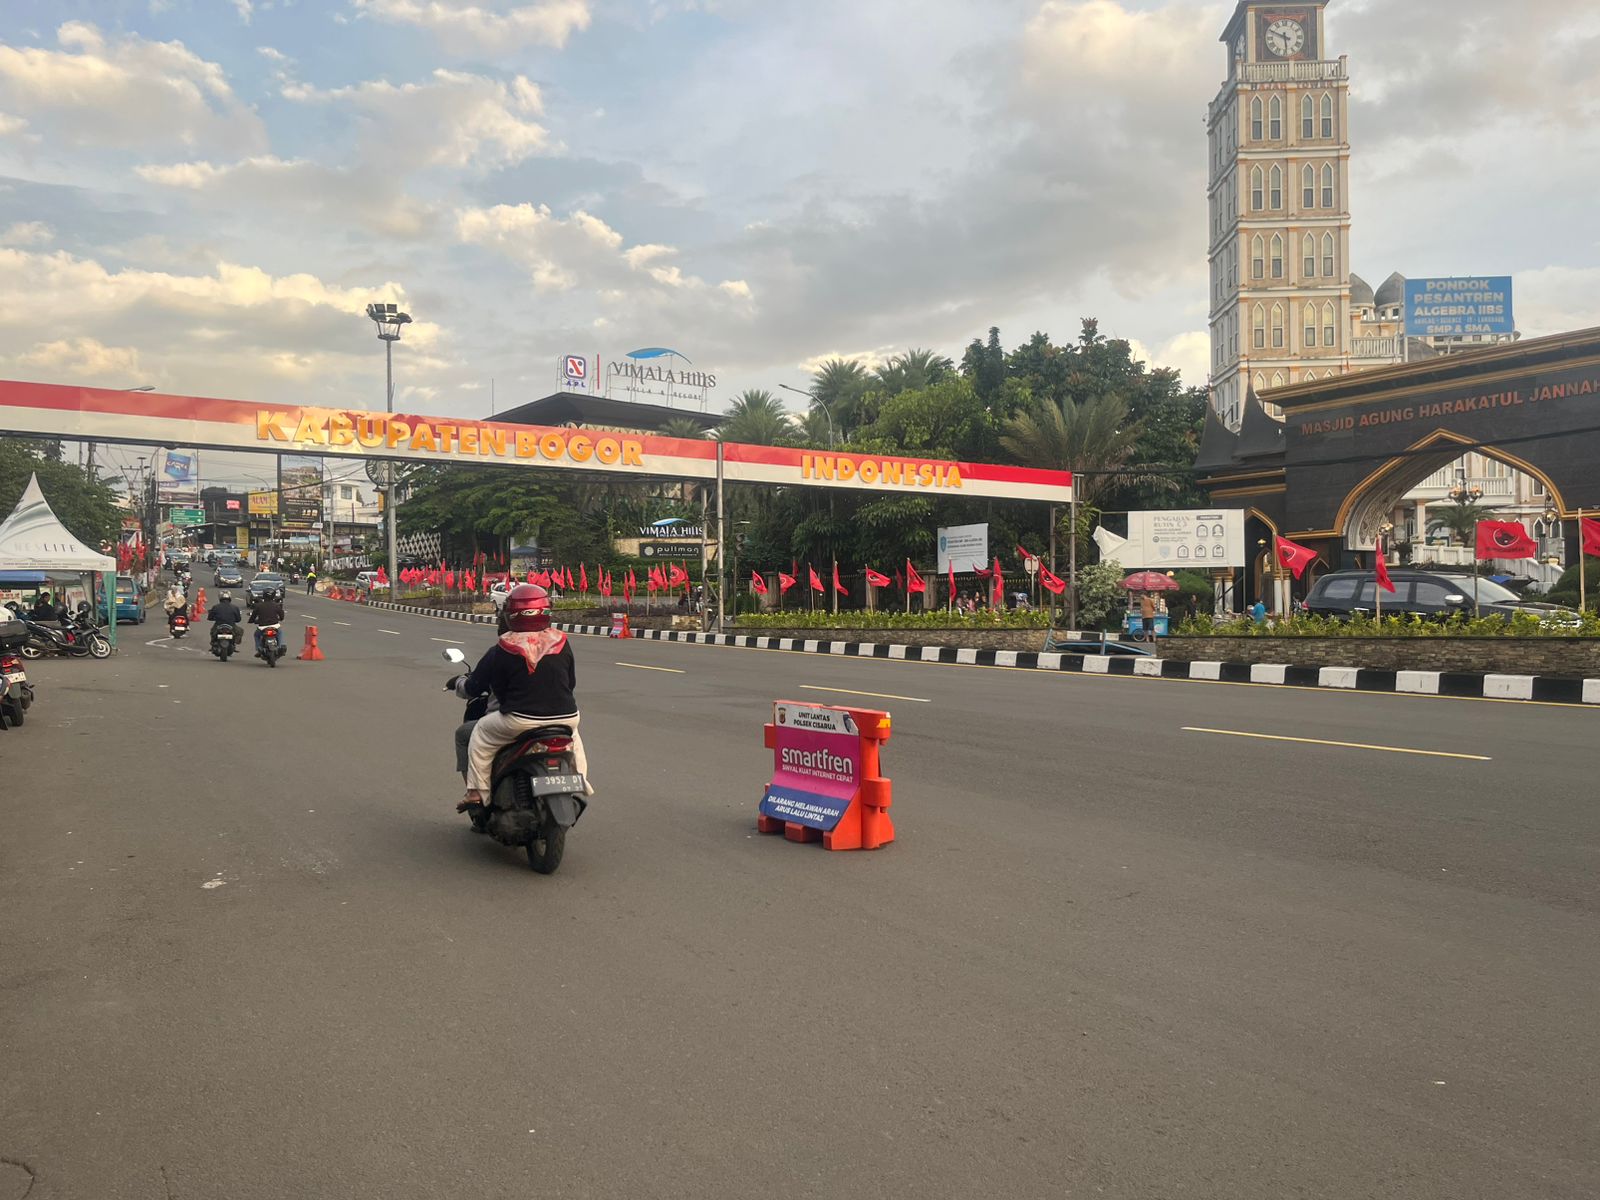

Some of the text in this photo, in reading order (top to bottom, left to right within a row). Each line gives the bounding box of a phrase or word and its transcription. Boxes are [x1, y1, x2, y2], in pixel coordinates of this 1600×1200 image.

[1426, 280, 1490, 291] PONDOK
[1414, 292, 1504, 304] PESANTREN
[1414, 304, 1504, 316] ALGEBRA IIBS
[1426, 324, 1491, 334] SMP & SMA
[611, 361, 676, 385] VIMALA
[566, 380, 586, 388] APL
[1301, 416, 1354, 436] MASJID
[1359, 407, 1414, 427] AGUNG
[1419, 391, 1523, 418] HARAKATUL
[255, 409, 644, 466] KABUPATEN BOGOR
[801, 455, 963, 488] INDONESIA
[640, 526, 678, 537] VIMALA
[657, 546, 699, 554] pullman
[811, 713, 831, 721] LANTAS
[793, 719, 836, 730] POLSEK CISARUA
[781, 747, 853, 774] smartfren
[782, 764, 853, 783] SINYAL KUAT INTERNET CEPAT
[532, 777, 538, 786] F
[544, 776, 567, 784] 3952
[767, 795, 840, 817] DILARANG MELAWAN ARAH
[775, 805, 825, 822] ARUS LALU LINTAS
